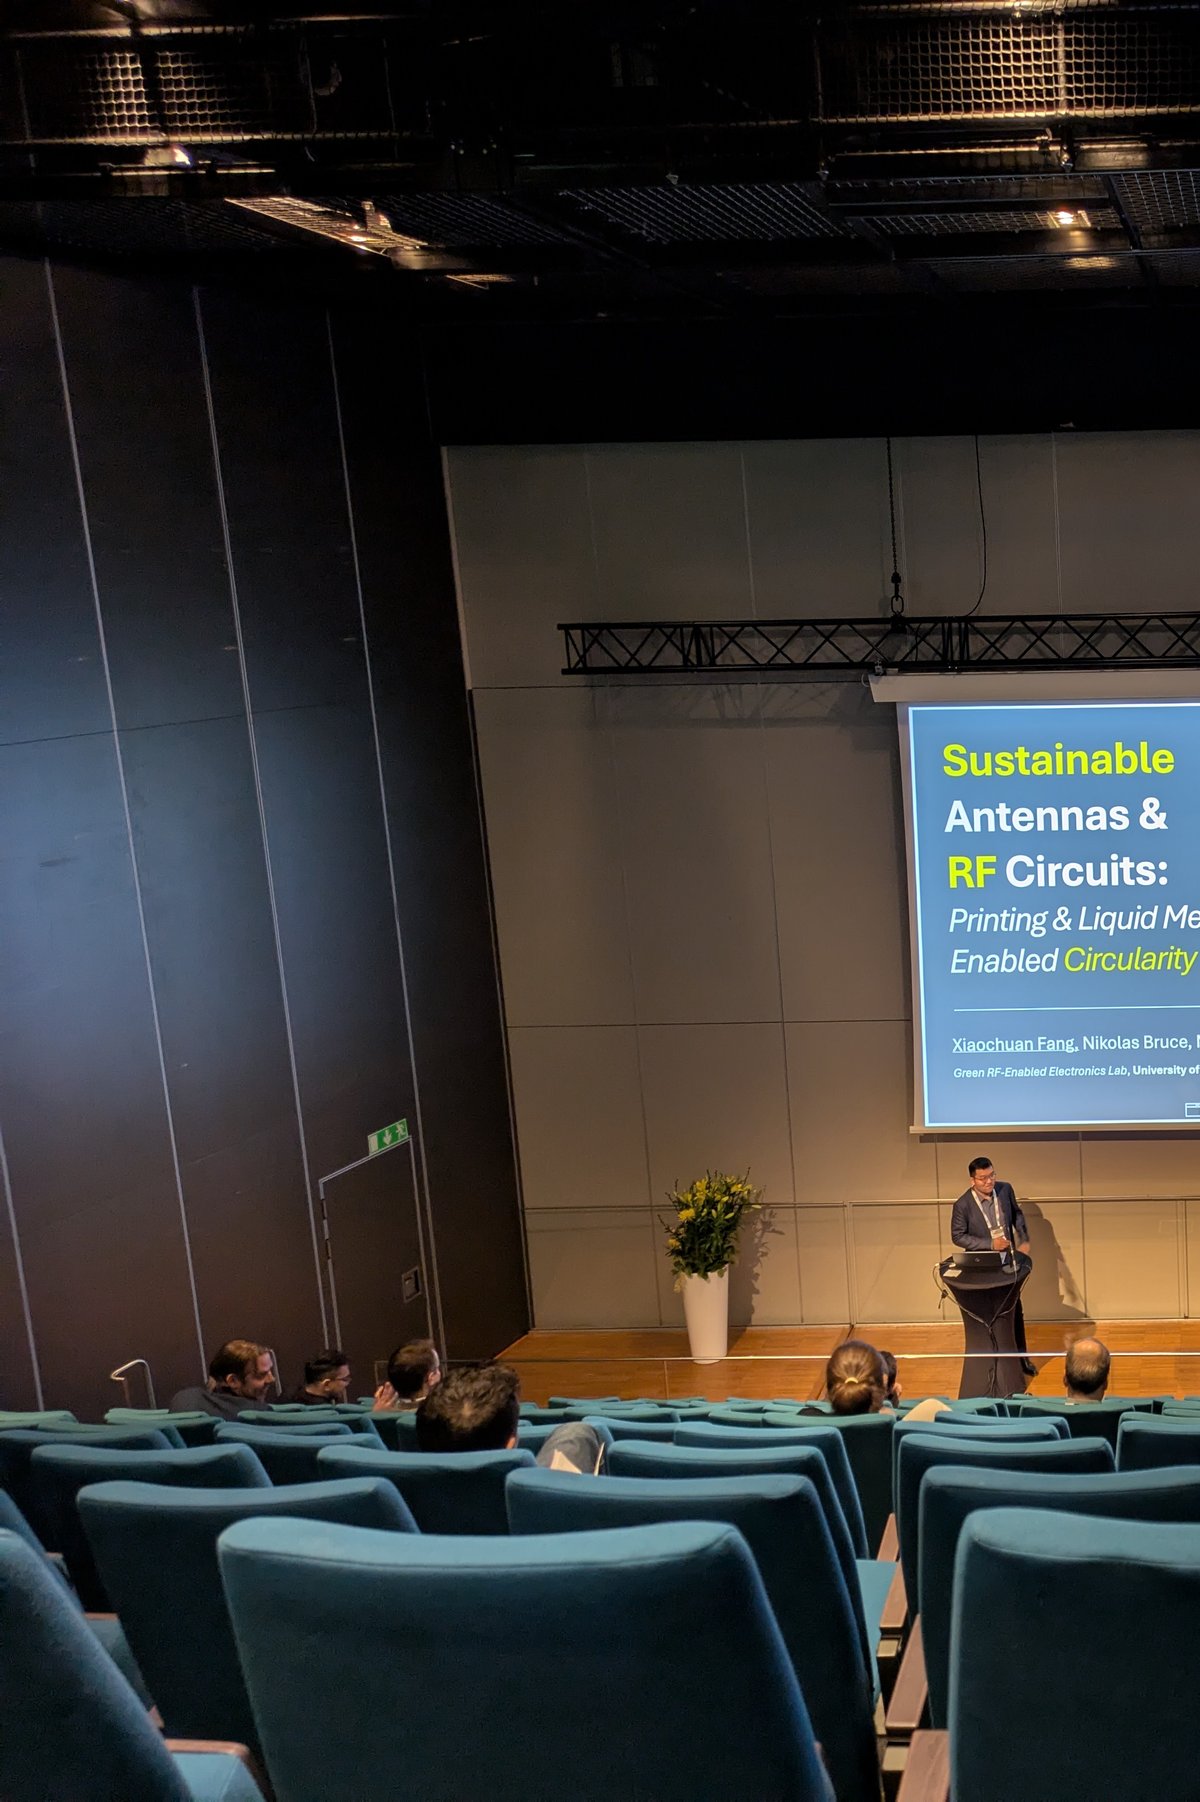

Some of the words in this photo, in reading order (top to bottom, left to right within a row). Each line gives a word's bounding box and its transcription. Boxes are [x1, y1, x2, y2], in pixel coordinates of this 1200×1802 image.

[943, 741, 1175, 777] Sustainable
[944, 799, 1130, 833] Antennas
[1139, 797, 1169, 830] &
[948, 855, 997, 889] RF
[1005, 853, 1169, 888] Circuits:
[949, 907, 1048, 938] Printing
[1053, 906, 1072, 931] &
[1078, 905, 1158, 935] Liquid
[950, 947, 1059, 974] Enabled
[1063, 945, 1198, 976] Circularity
[952, 1037, 1034, 1052] Xiaochuan
[1037, 1036, 1079, 1053] Fang,
[1083, 1035, 1140, 1050] Nikolas
[1143, 1035, 1192, 1050] Bruce,
[954, 1068, 984, 1078] Green
[987, 1067, 1047, 1078] RF-Enabled
[1048, 1066, 1106, 1077] Electronics
[1108, 1065, 1131, 1077] Lab,
[1132, 1065, 1187, 1076] University
[1189, 1064, 1200, 1074] of
